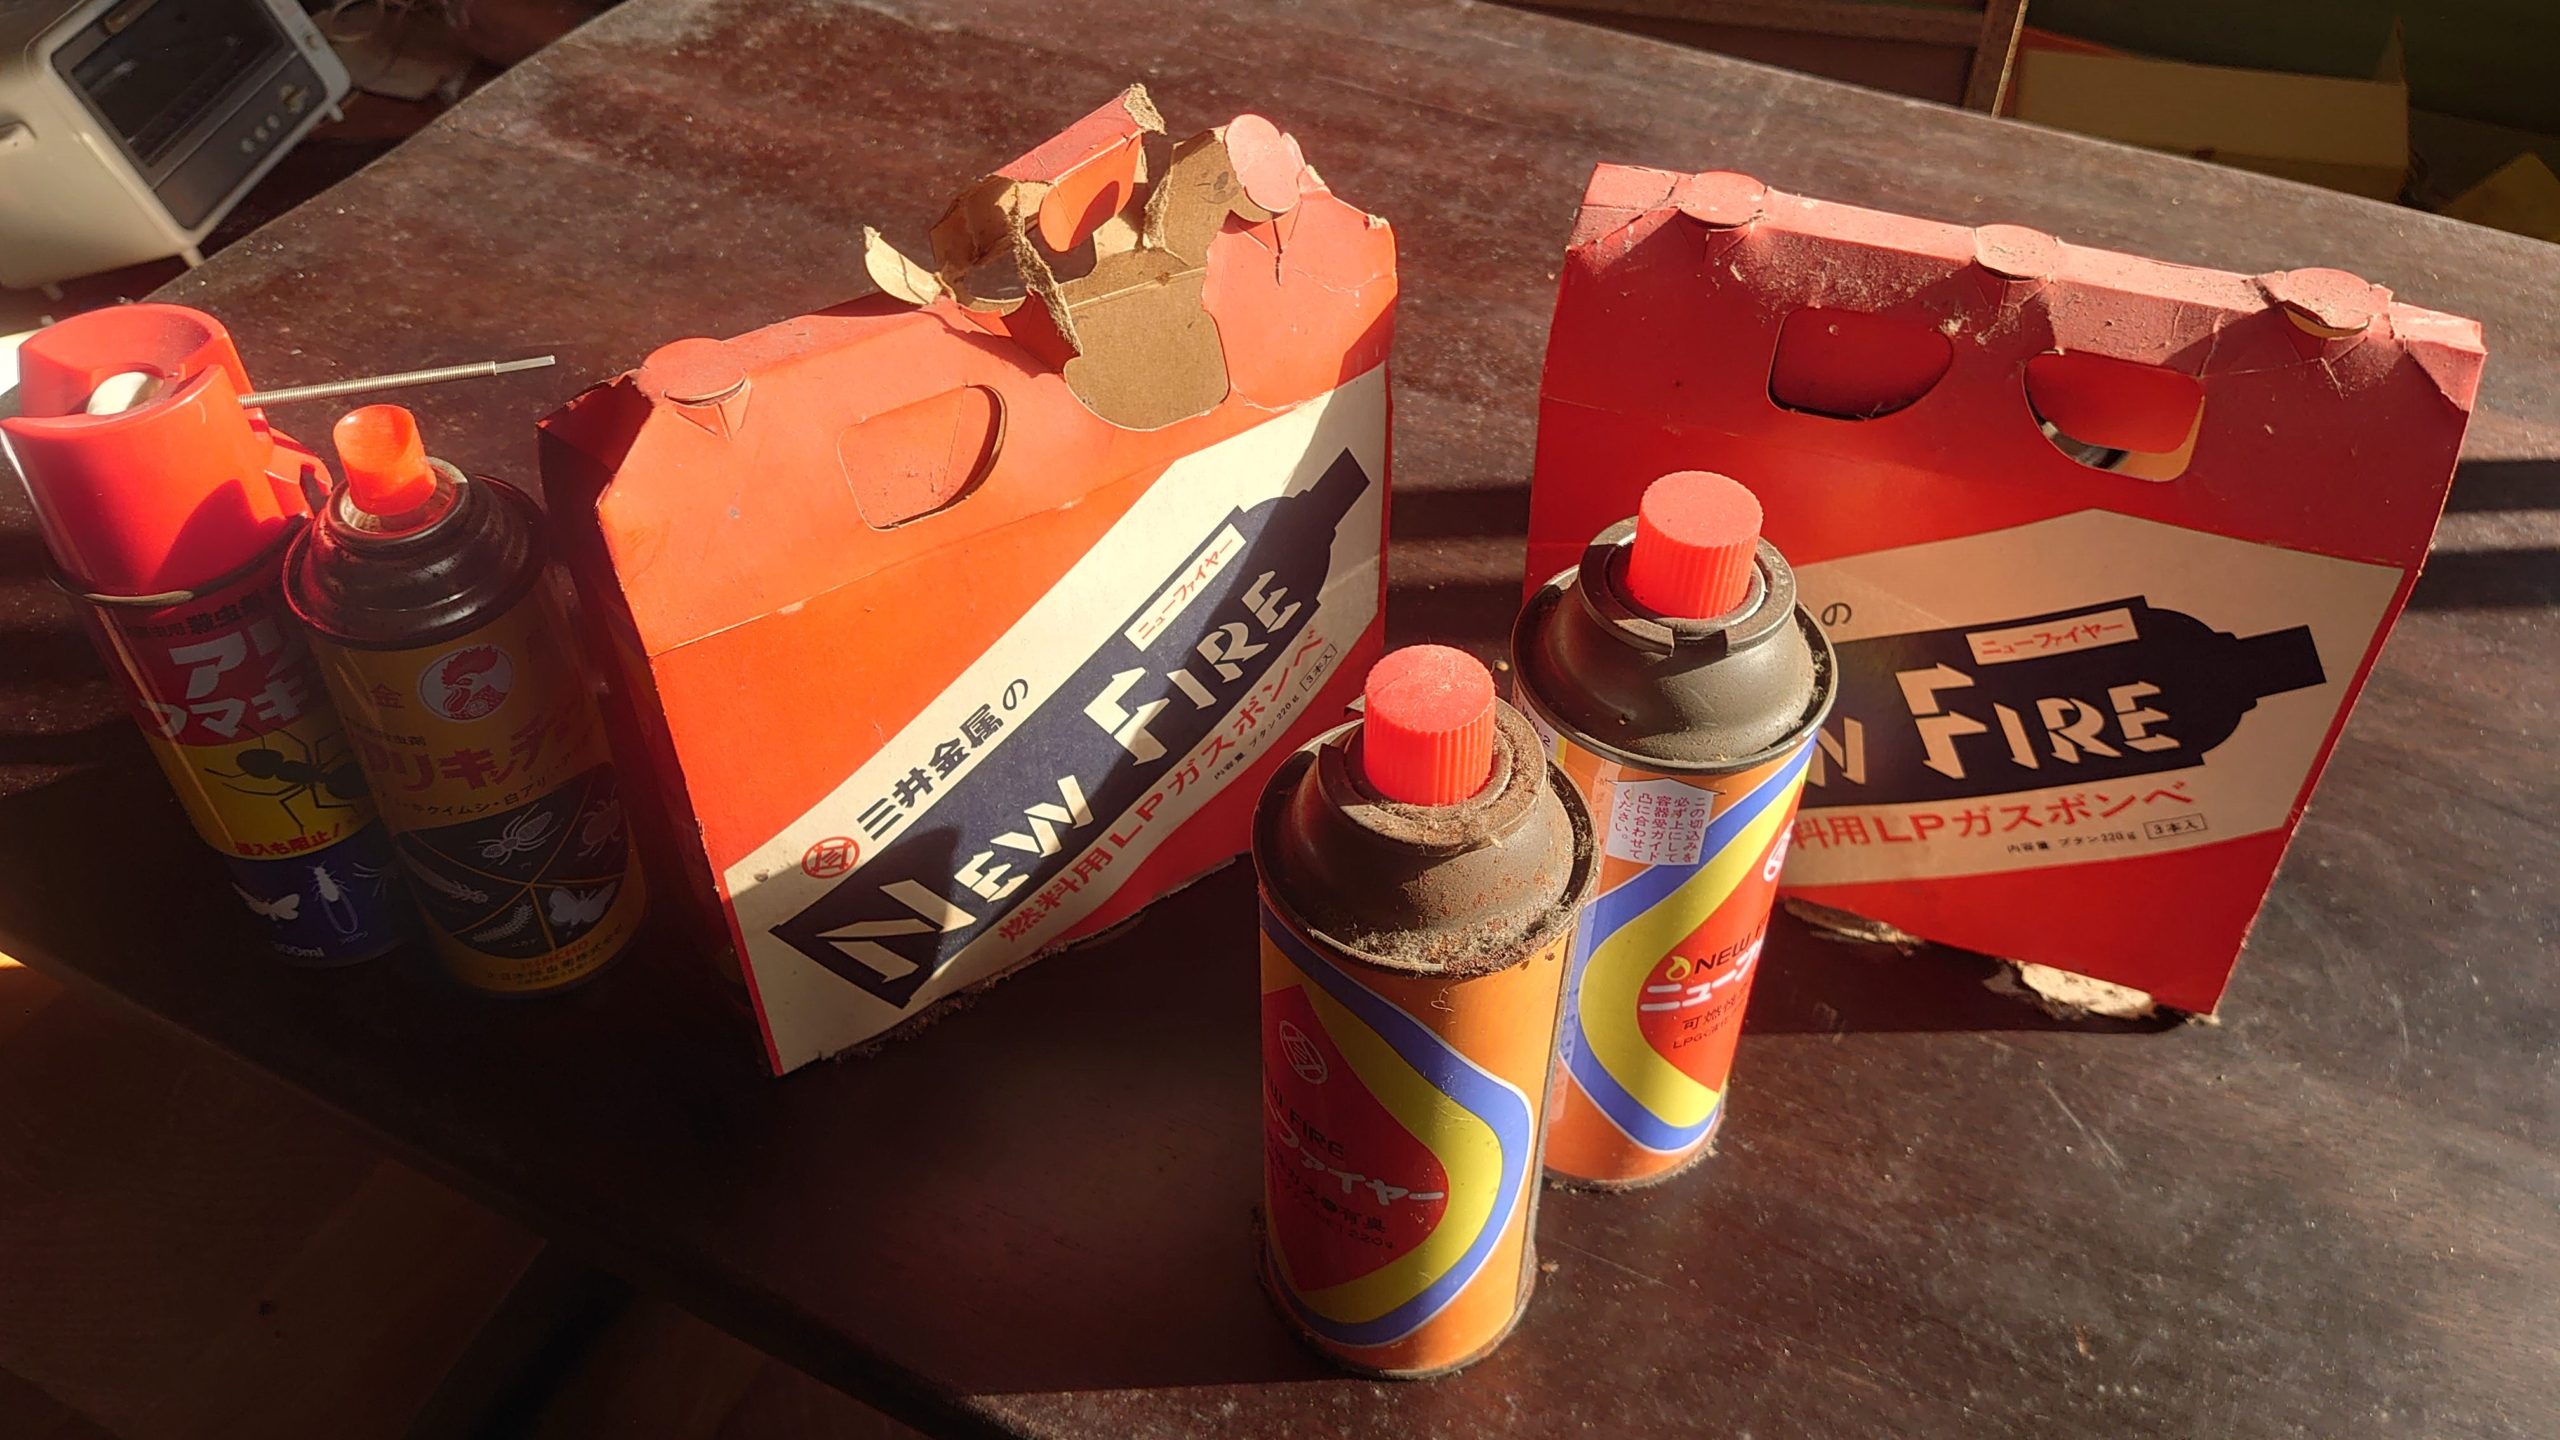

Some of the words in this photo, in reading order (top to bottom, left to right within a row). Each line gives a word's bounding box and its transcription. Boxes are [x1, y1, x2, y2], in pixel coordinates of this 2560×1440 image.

[1137, 538, 1234, 641] ニューファイヤー
[1084, 570, 1302, 766] FIRE
[1981, 622, 2125, 656] ニューファイヤー
[1895, 661, 2181, 780] FIRE
[1665, 796, 1690, 863] 必ず上にして
[1793, 780, 2194, 850] 料用LPガスボンベ
[815, 774, 1095, 983] NEW
[1694, 933, 1752, 976] NEW
[1288, 1107, 1346, 1162] FIRE
